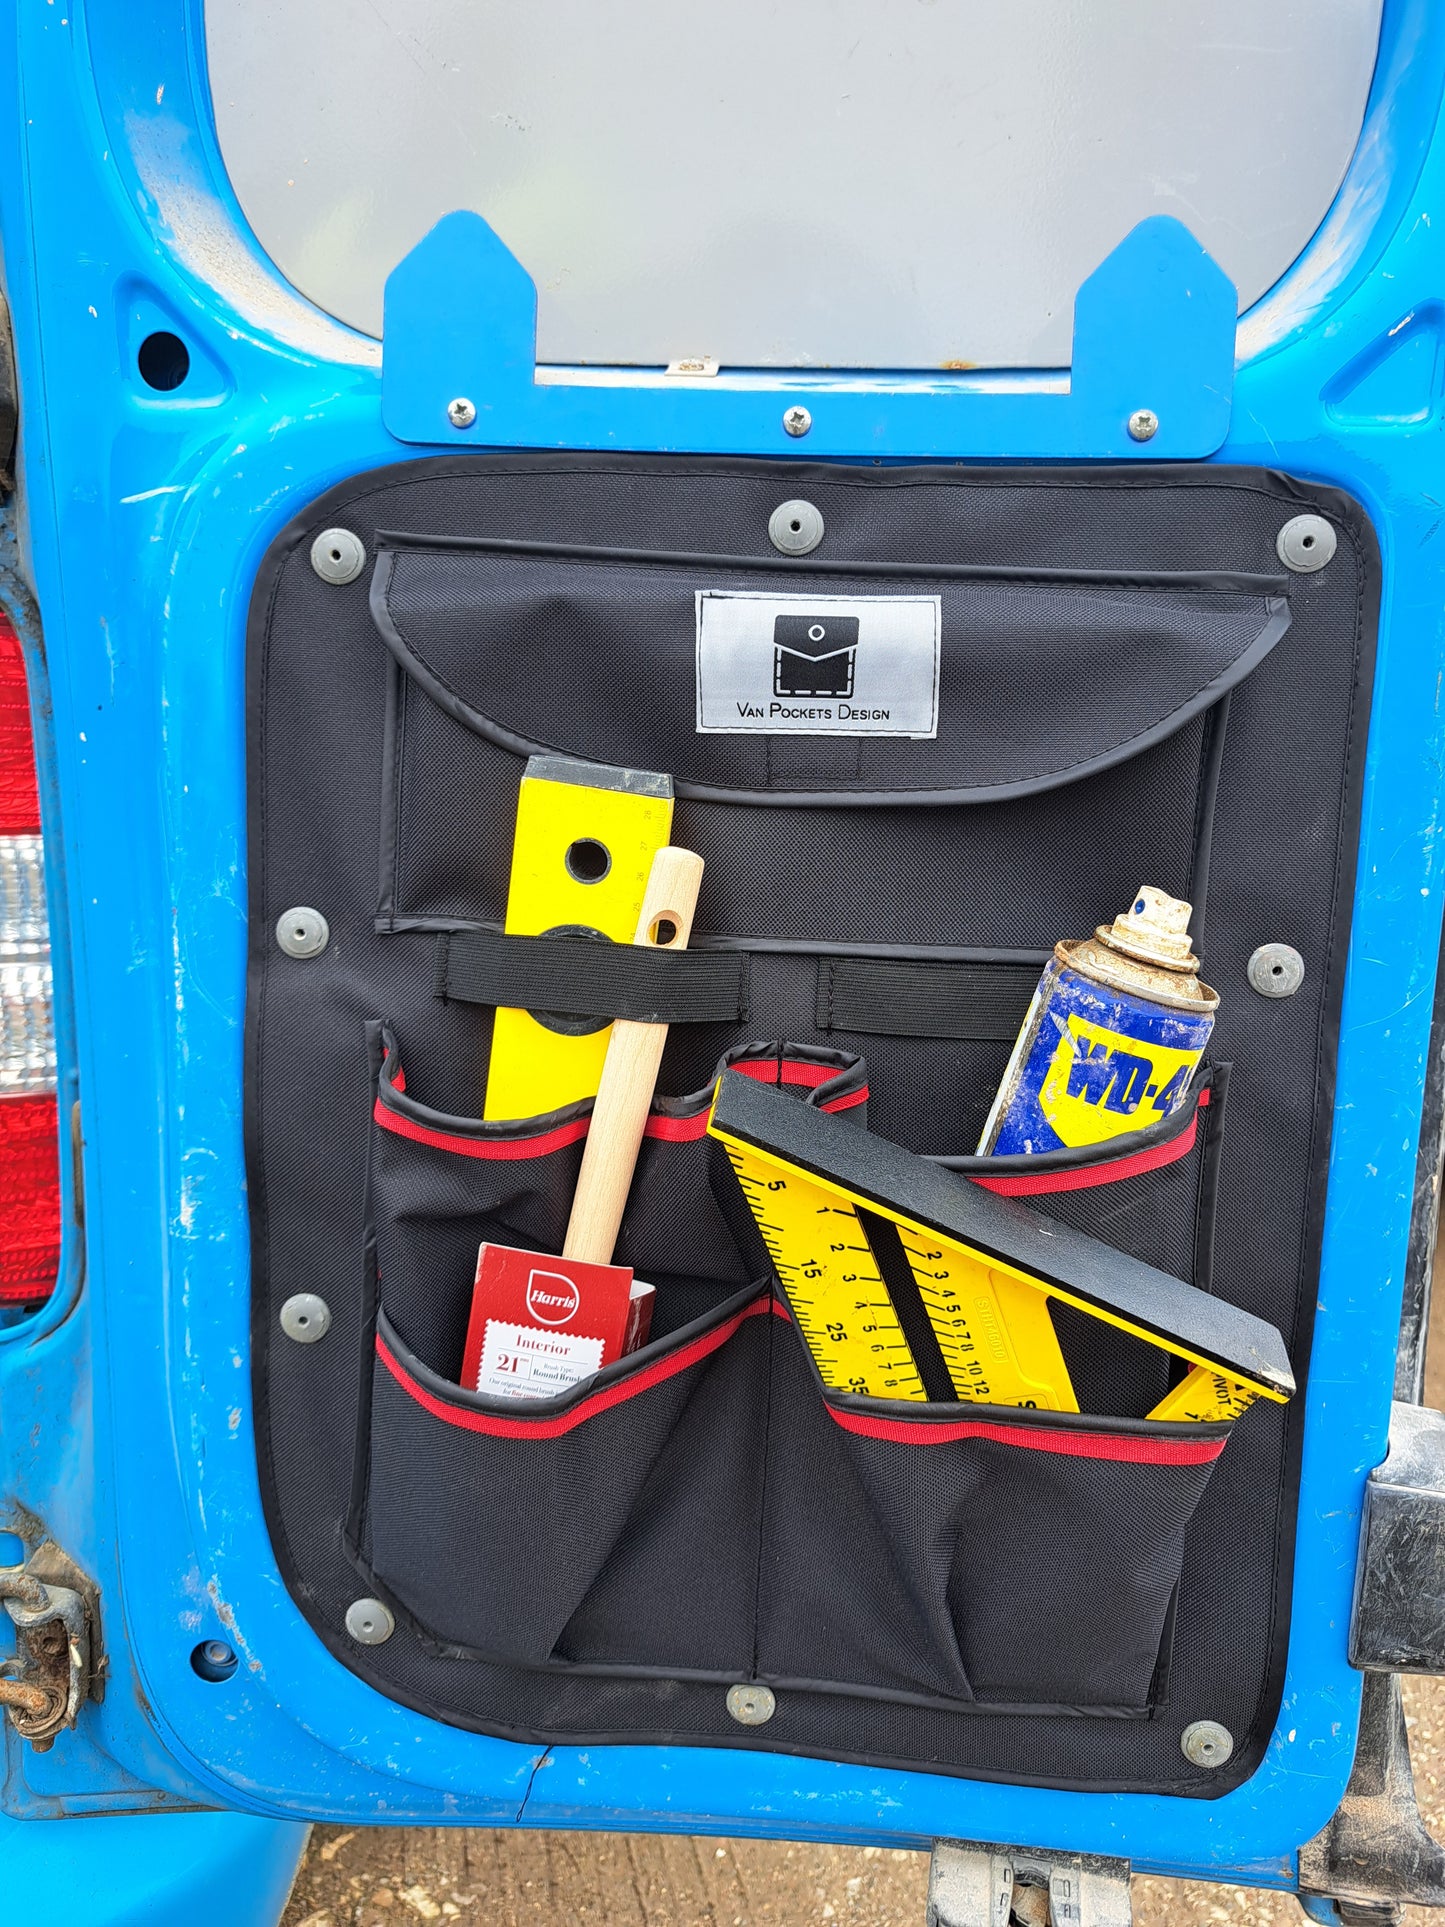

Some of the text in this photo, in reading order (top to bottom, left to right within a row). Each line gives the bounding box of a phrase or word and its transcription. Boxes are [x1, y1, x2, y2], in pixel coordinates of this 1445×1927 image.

[640, 840, 648, 851] 27
[636, 871, 645, 882] 26
[632, 901, 641, 912] 25
[1066, 1034, 1194, 1118] WD-4
[830, 1243, 845, 1252] 2
[767, 1179, 787, 1192] 5
[801, 1258, 822, 1279] 15
[825, 1322, 848, 1342] 25
[843, 1274, 857, 1282] 3
[530, 1289, 575, 1309] Harris
[854, 1301, 868, 1309] 4
[862, 1324, 877, 1333] 5
[927, 1251, 990, 1395] 2 3 4 5 6 7 8 10 12
[516, 1334, 571, 1356] Interior
[870, 1344, 885, 1352] 6
[496, 1353, 519, 1373] 21
[878, 1362, 893, 1370] 7
[533, 1368, 559, 1380] Round
[884, 1379, 898, 1387] 8
[1211, 1372, 1232, 1405] IVOT
